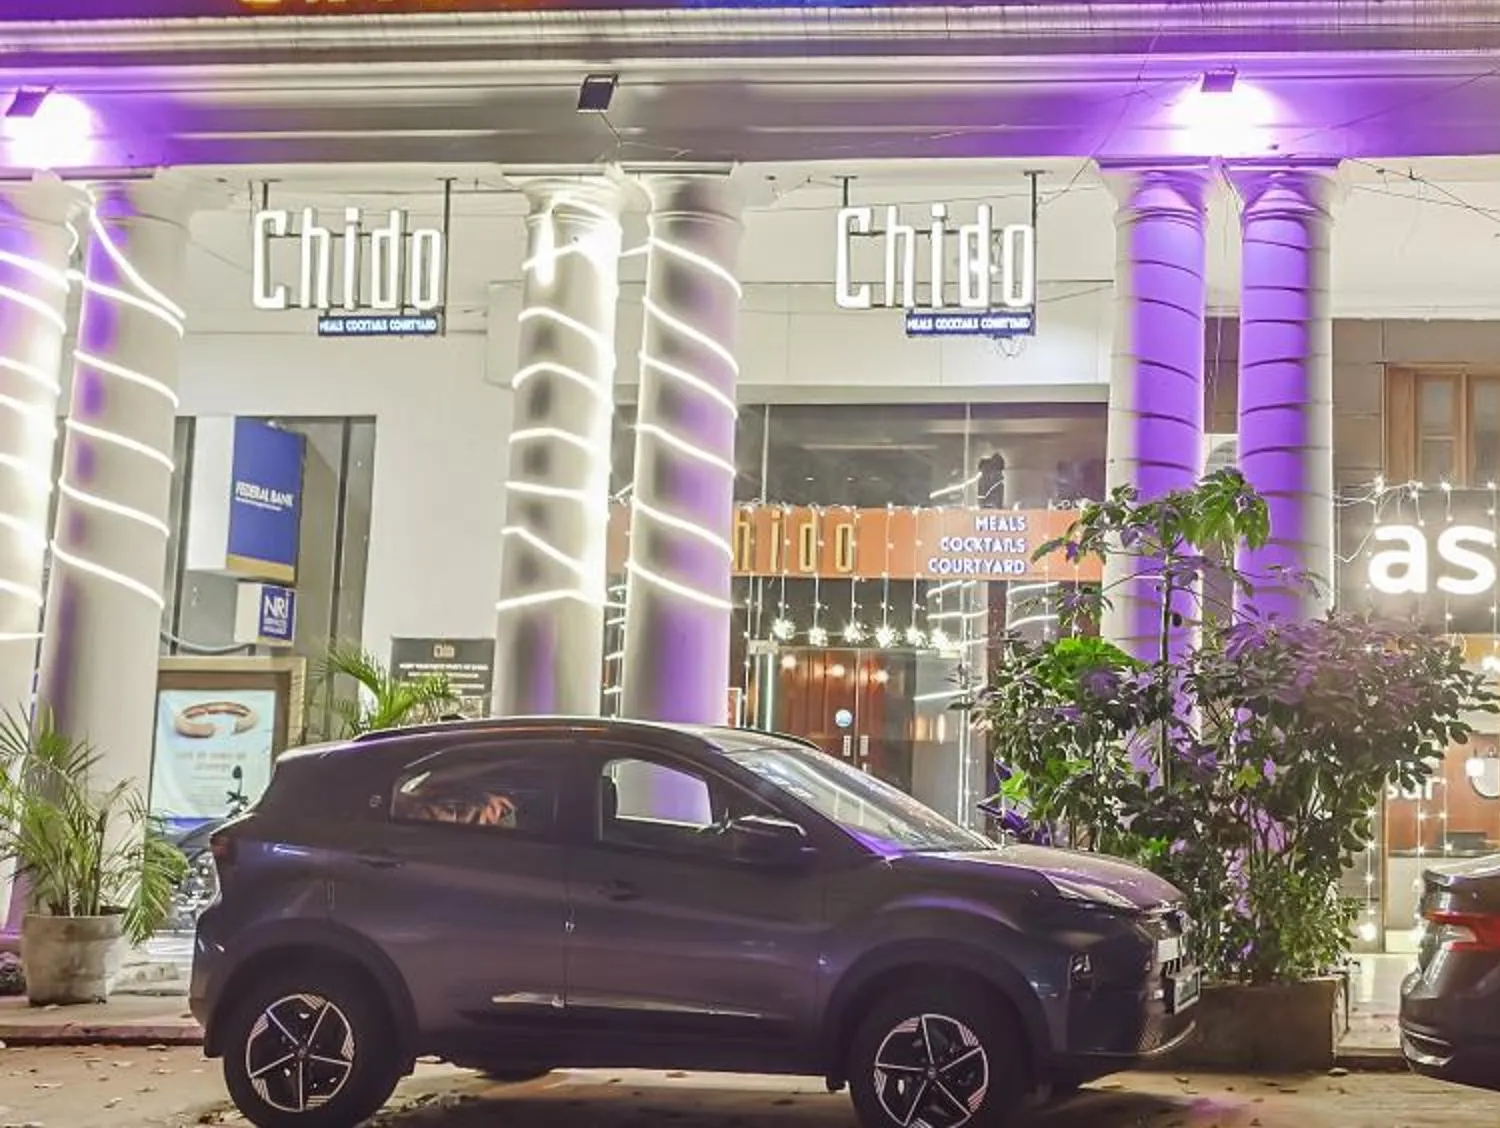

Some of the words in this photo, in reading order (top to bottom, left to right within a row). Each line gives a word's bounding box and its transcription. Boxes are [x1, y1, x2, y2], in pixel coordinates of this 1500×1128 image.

[253, 207, 441, 311] Chido
[836, 203, 1034, 308] Chido
[734, 508, 852, 572] hido
[975, 515, 1025, 531] MEALS
[940, 536, 1025, 553] COCKTAILS
[928, 557, 1025, 575] COURTYARD
